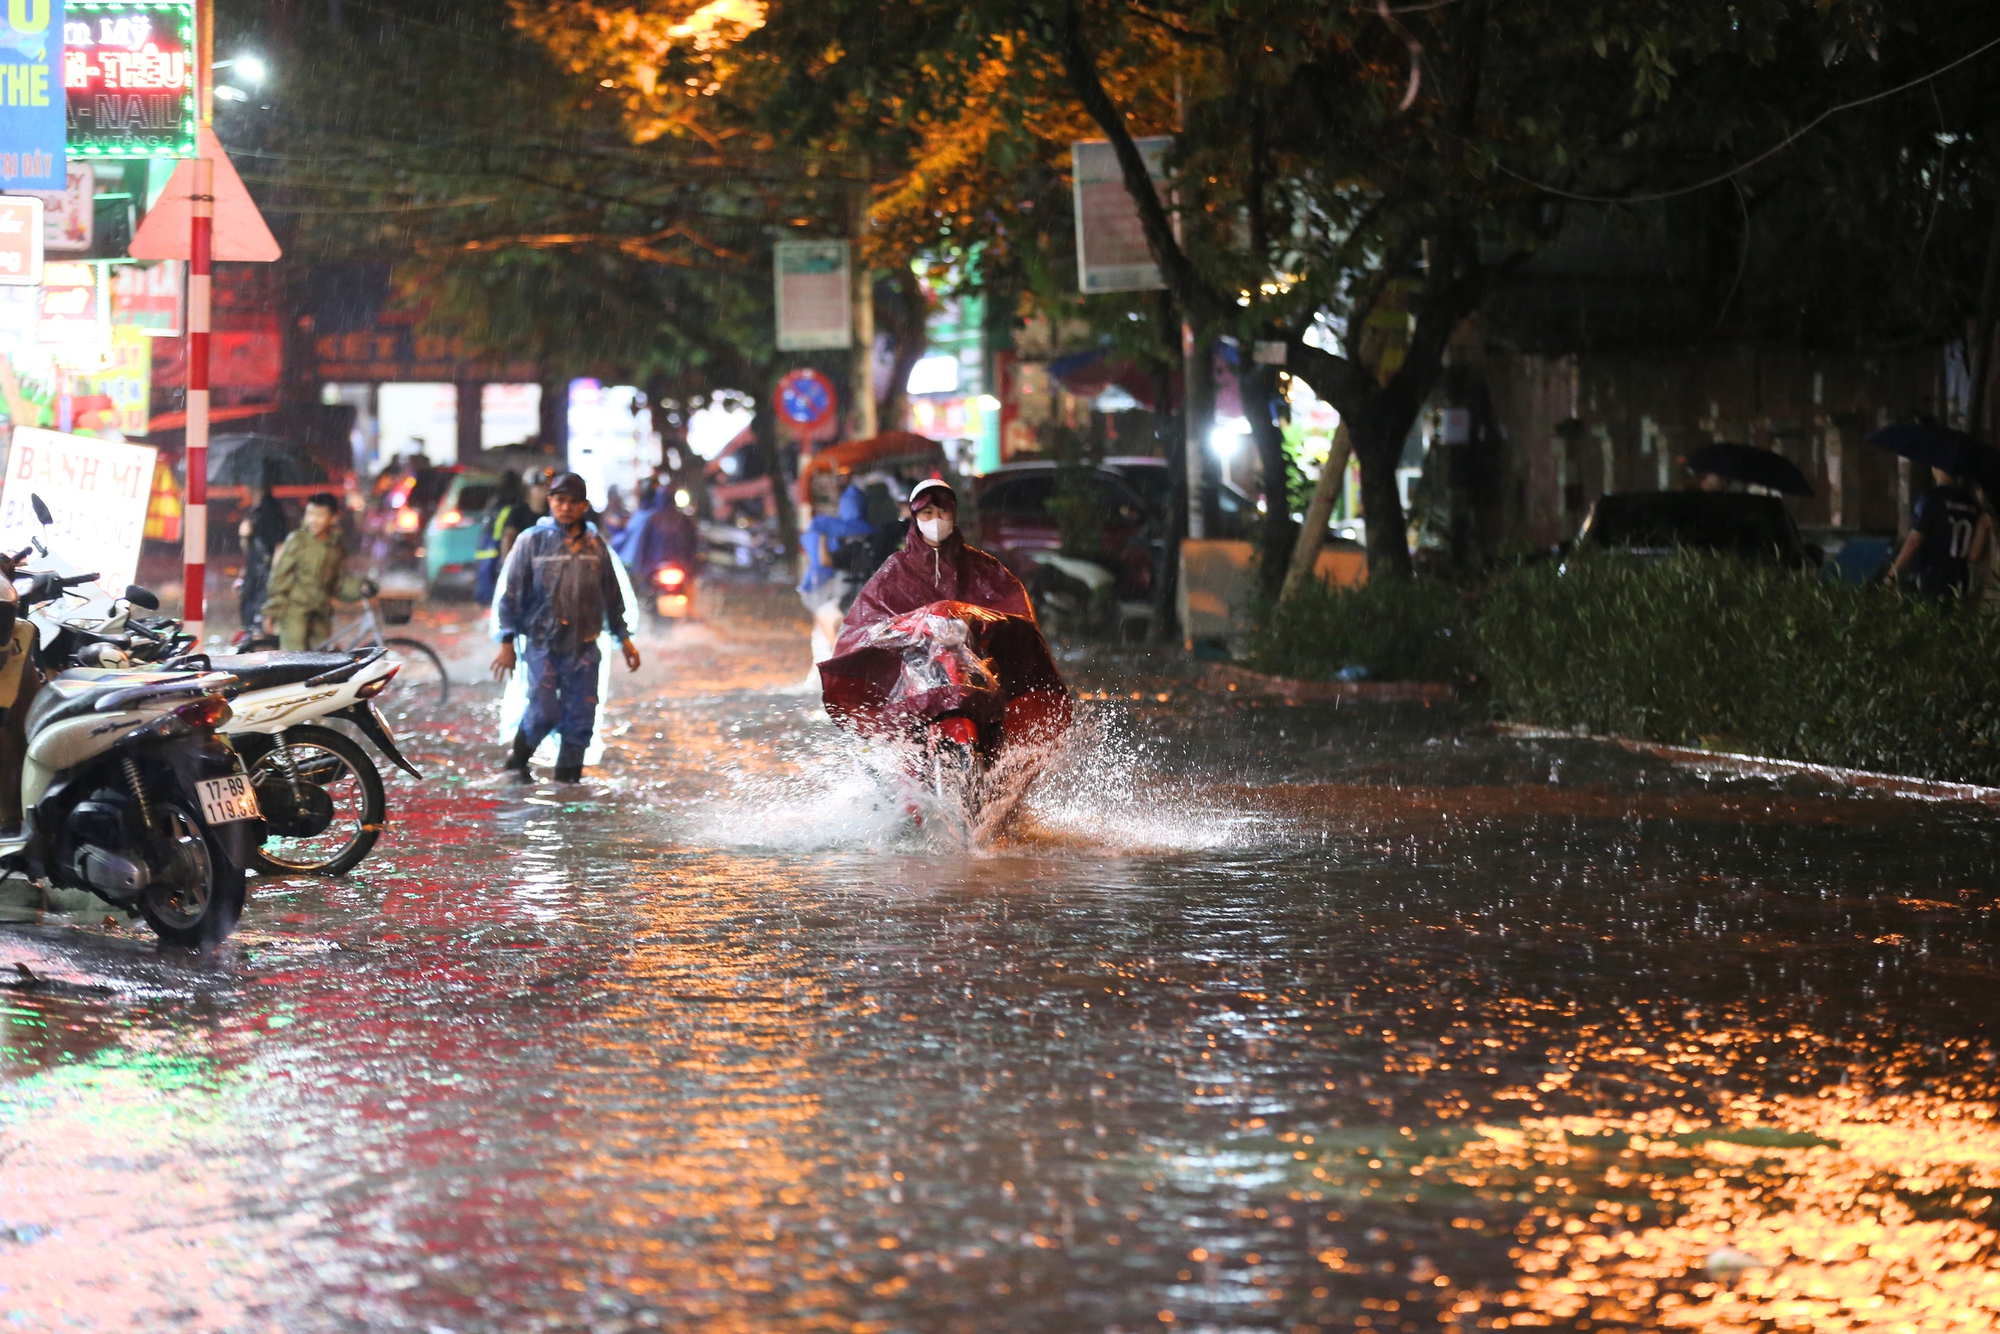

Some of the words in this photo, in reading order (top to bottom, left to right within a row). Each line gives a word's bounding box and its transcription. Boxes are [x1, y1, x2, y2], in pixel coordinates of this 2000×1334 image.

[164, 135, 175, 147] 2
[22, 148, 52, 179] ĐÂY
[17, 440, 100, 492] BÁNH
[205, 777, 246, 800] 17-B9
